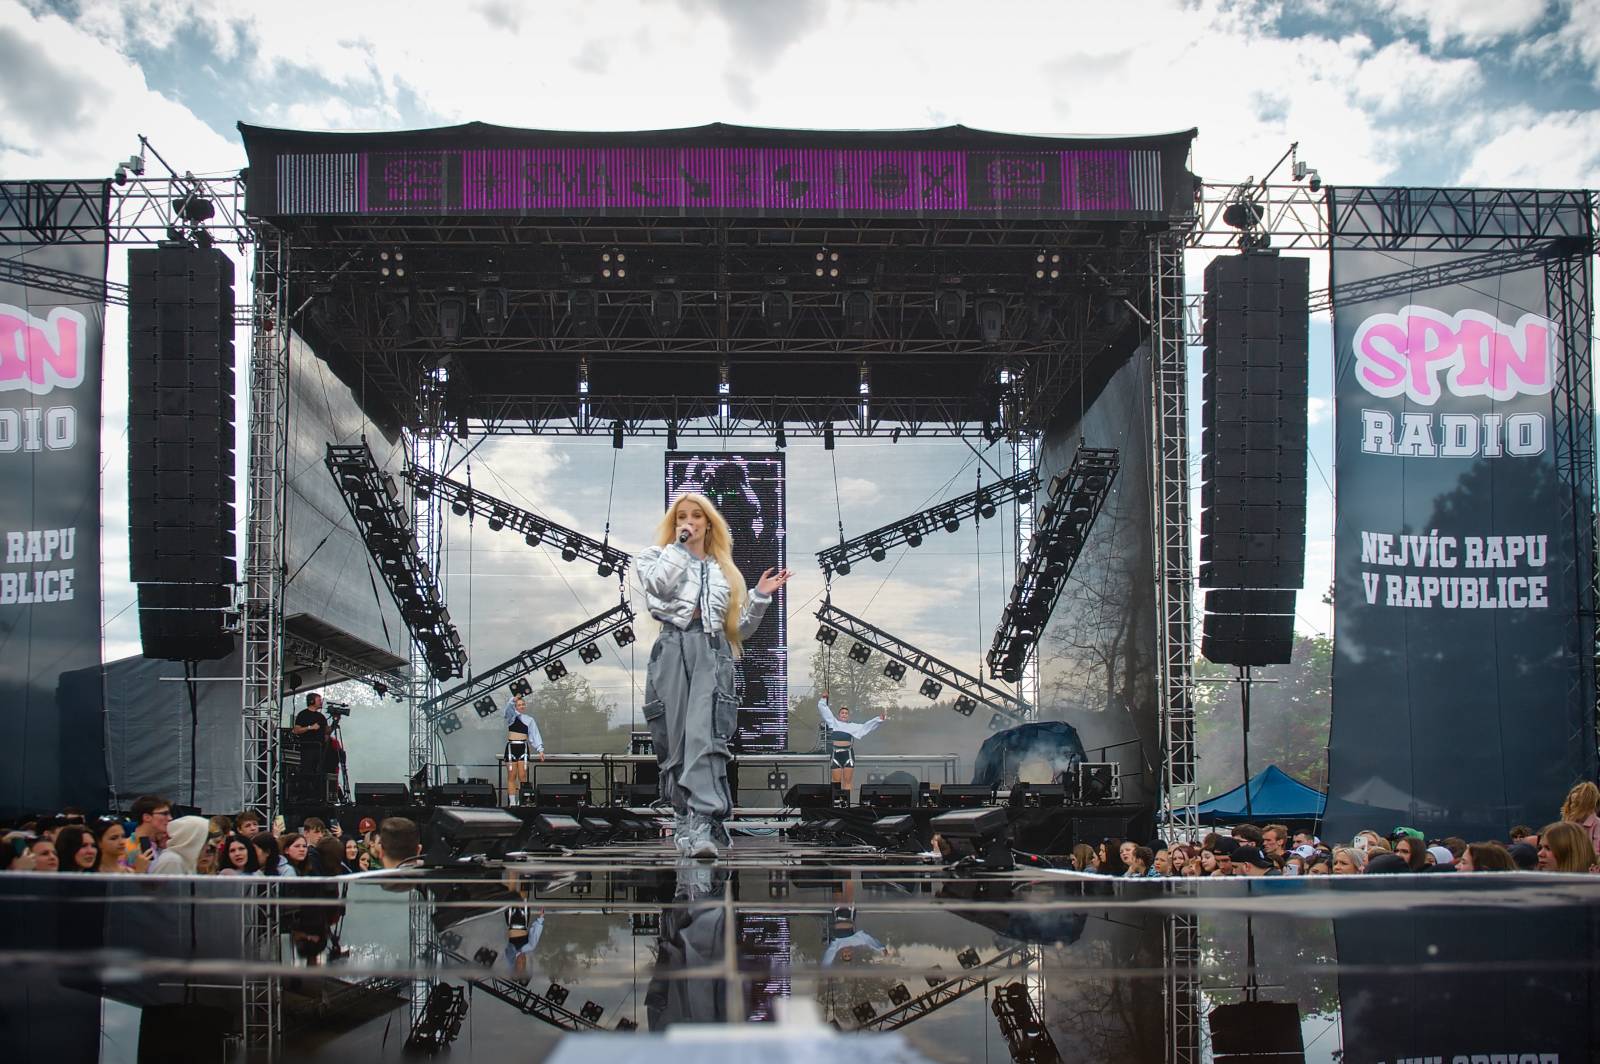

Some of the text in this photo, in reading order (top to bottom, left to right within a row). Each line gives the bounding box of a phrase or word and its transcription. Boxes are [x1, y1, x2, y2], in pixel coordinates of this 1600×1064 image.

[0, 304, 86, 394] IN
[1355, 307, 1556, 404] SPIN
[0, 405, 77, 452] DIO
[1361, 408, 1546, 458] RADIO
[6, 528, 76, 564] RAPU
[1361, 529, 1548, 568] NEJVÍC RAPU
[0, 569, 74, 604] BLICE
[1362, 572, 1548, 608] V RAPUBLICE
